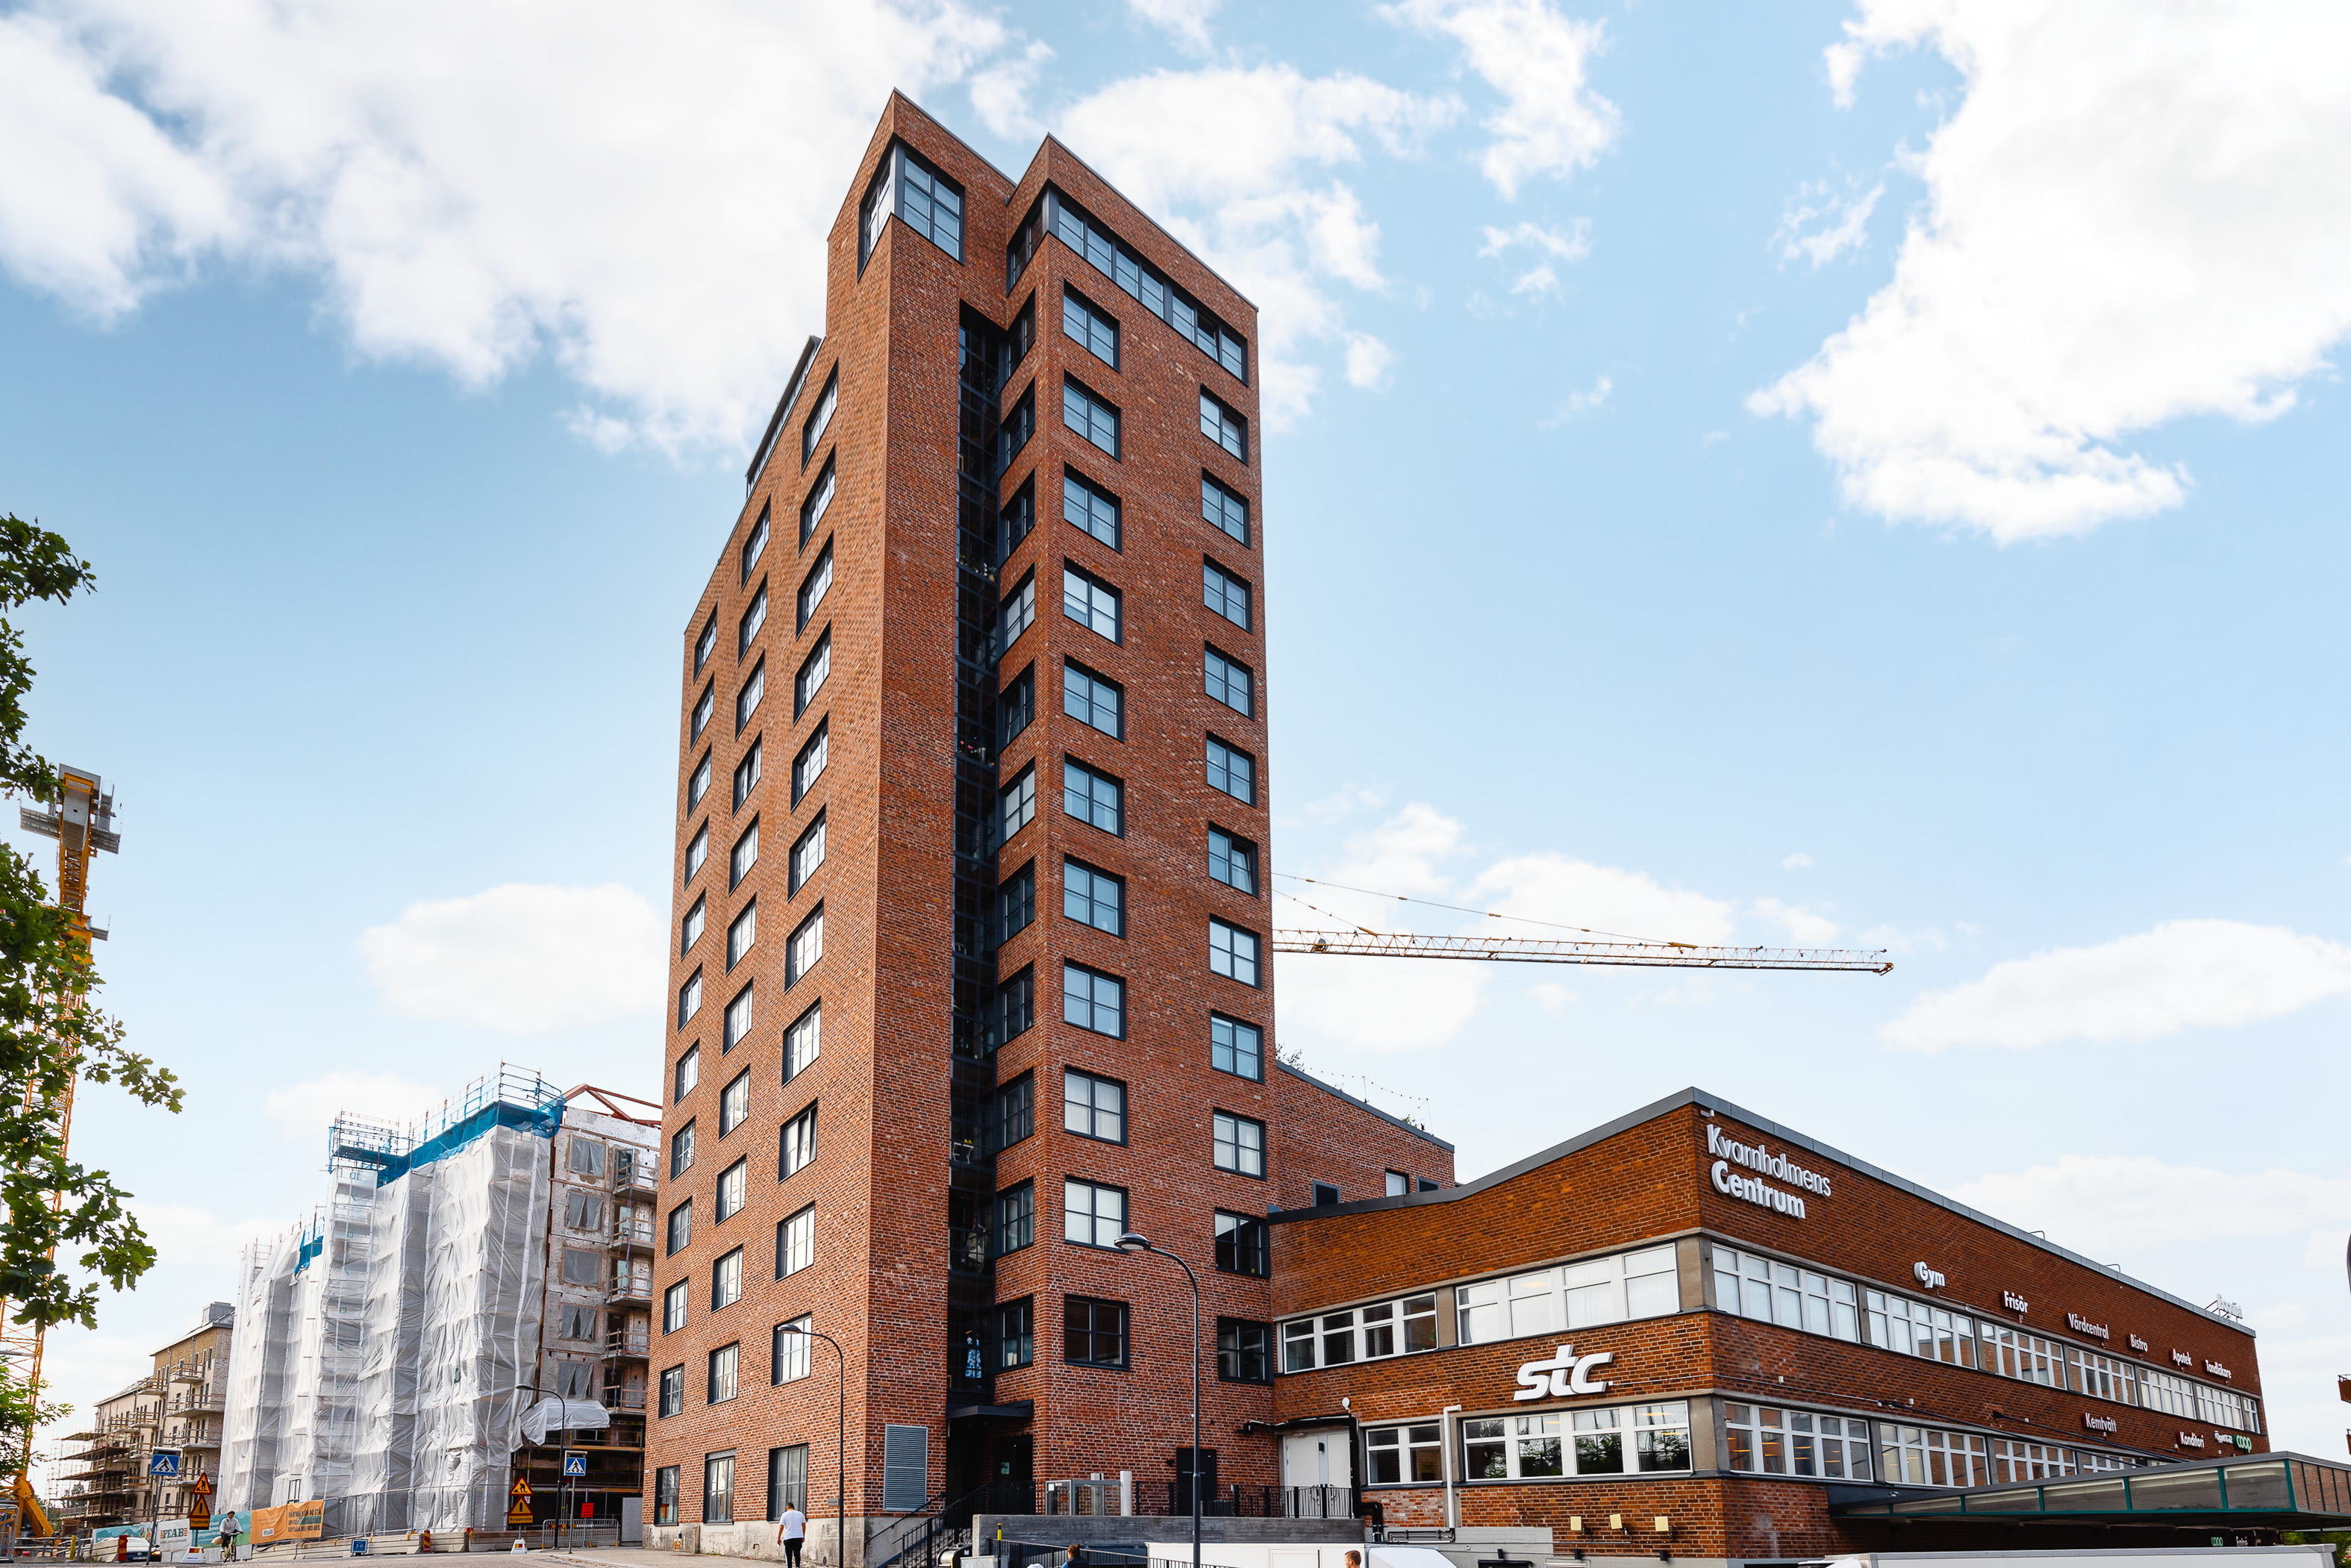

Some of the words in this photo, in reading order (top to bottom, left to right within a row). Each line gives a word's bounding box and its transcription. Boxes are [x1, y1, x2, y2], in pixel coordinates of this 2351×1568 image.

[1707, 1124, 1831, 1197] Kvarnholmens
[1711, 1160, 1806, 1219] Centrum
[1914, 1261, 1946, 1288] Gym
[2003, 1290, 2029, 1314] Frisör
[2067, 1312, 2110, 1340] Vårdcentral
[2129, 1333, 2148, 1352] Bistro
[2173, 1348, 2193, 1366] Apotek
[1513, 1344, 1614, 1401] stc
[2205, 1359, 2232, 1379] Tandläkare
[2085, 1412, 2117, 1432] Kemtvätt
[2179, 1431, 2205, 1449] Konditori
[2236, 1434, 2252, 1453] coop
[163, 1528, 184, 1538] PEAB
